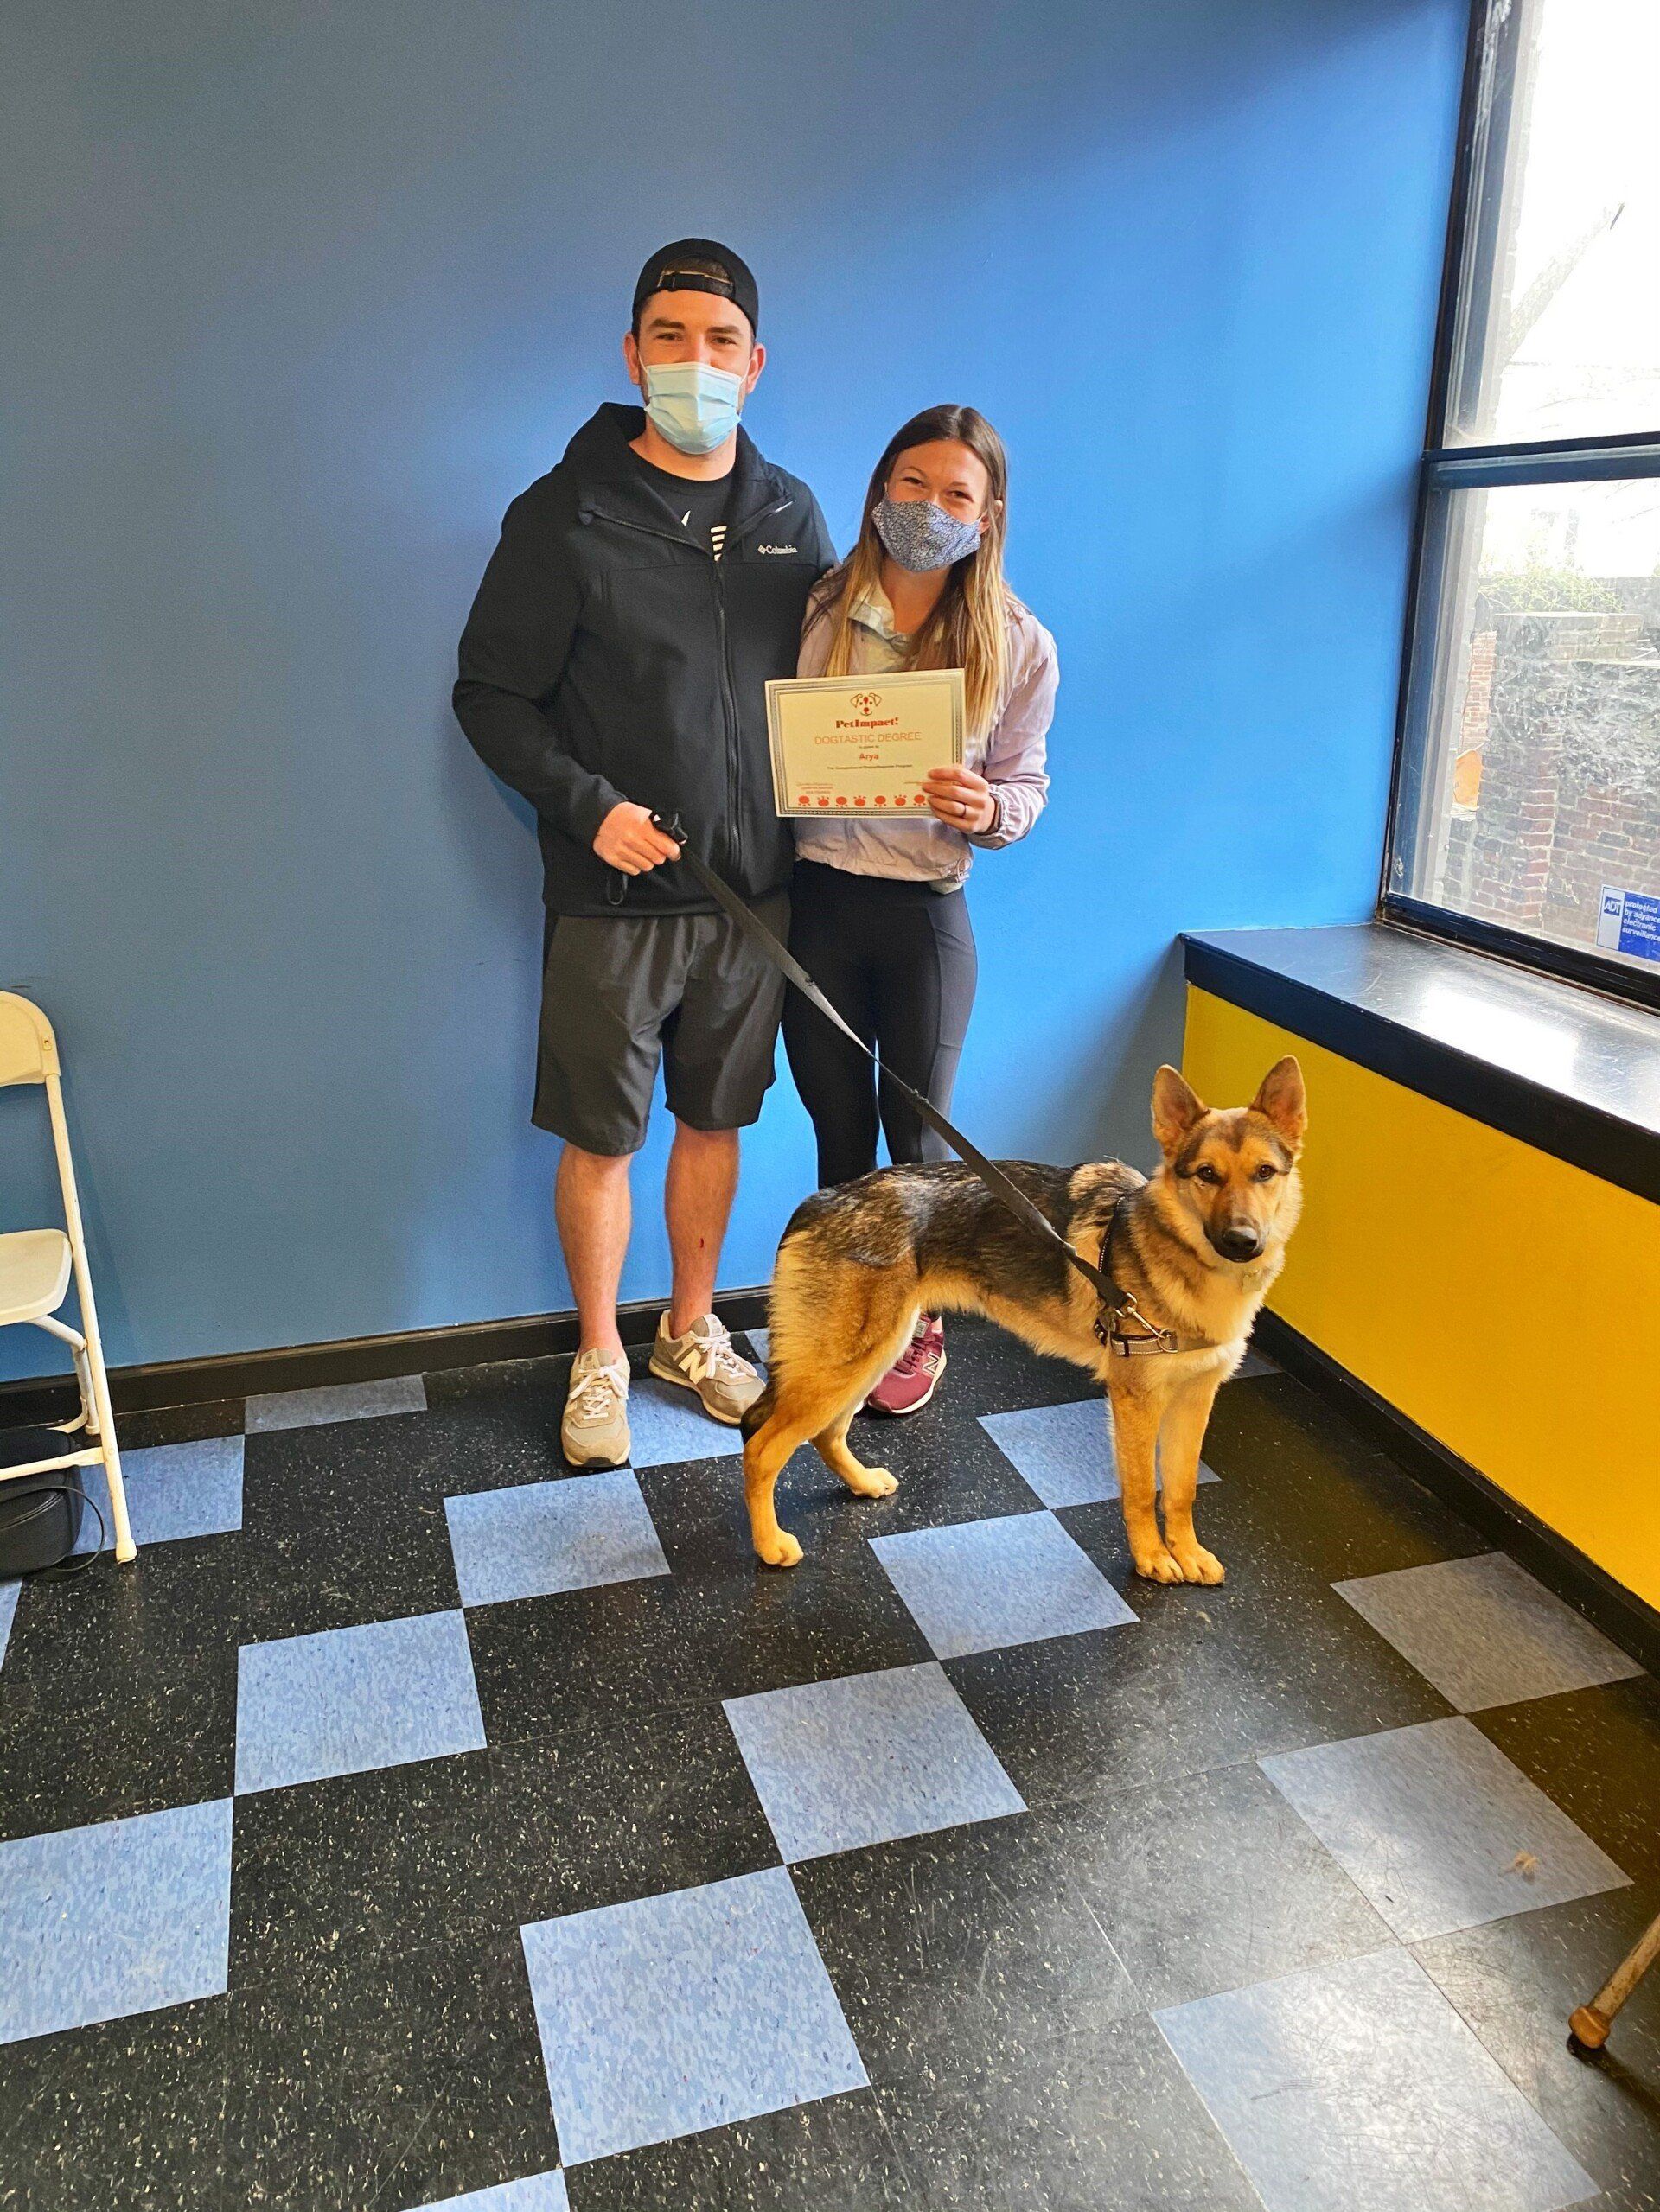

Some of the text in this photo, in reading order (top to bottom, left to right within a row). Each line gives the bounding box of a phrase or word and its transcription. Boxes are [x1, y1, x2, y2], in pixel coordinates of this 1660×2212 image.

[765, 545, 798, 555] Columbia
[835, 717, 899, 730] PetImpact!
[814, 731, 922, 744] DOGTASTIC DEGREE
[859, 752, 879, 761] Arya
[1604, 899, 1622, 914] ADT
[1625, 901, 1658, 913] protected
[1624, 908, 1632, 918] by
[1623, 918, 1657, 931] electronic
